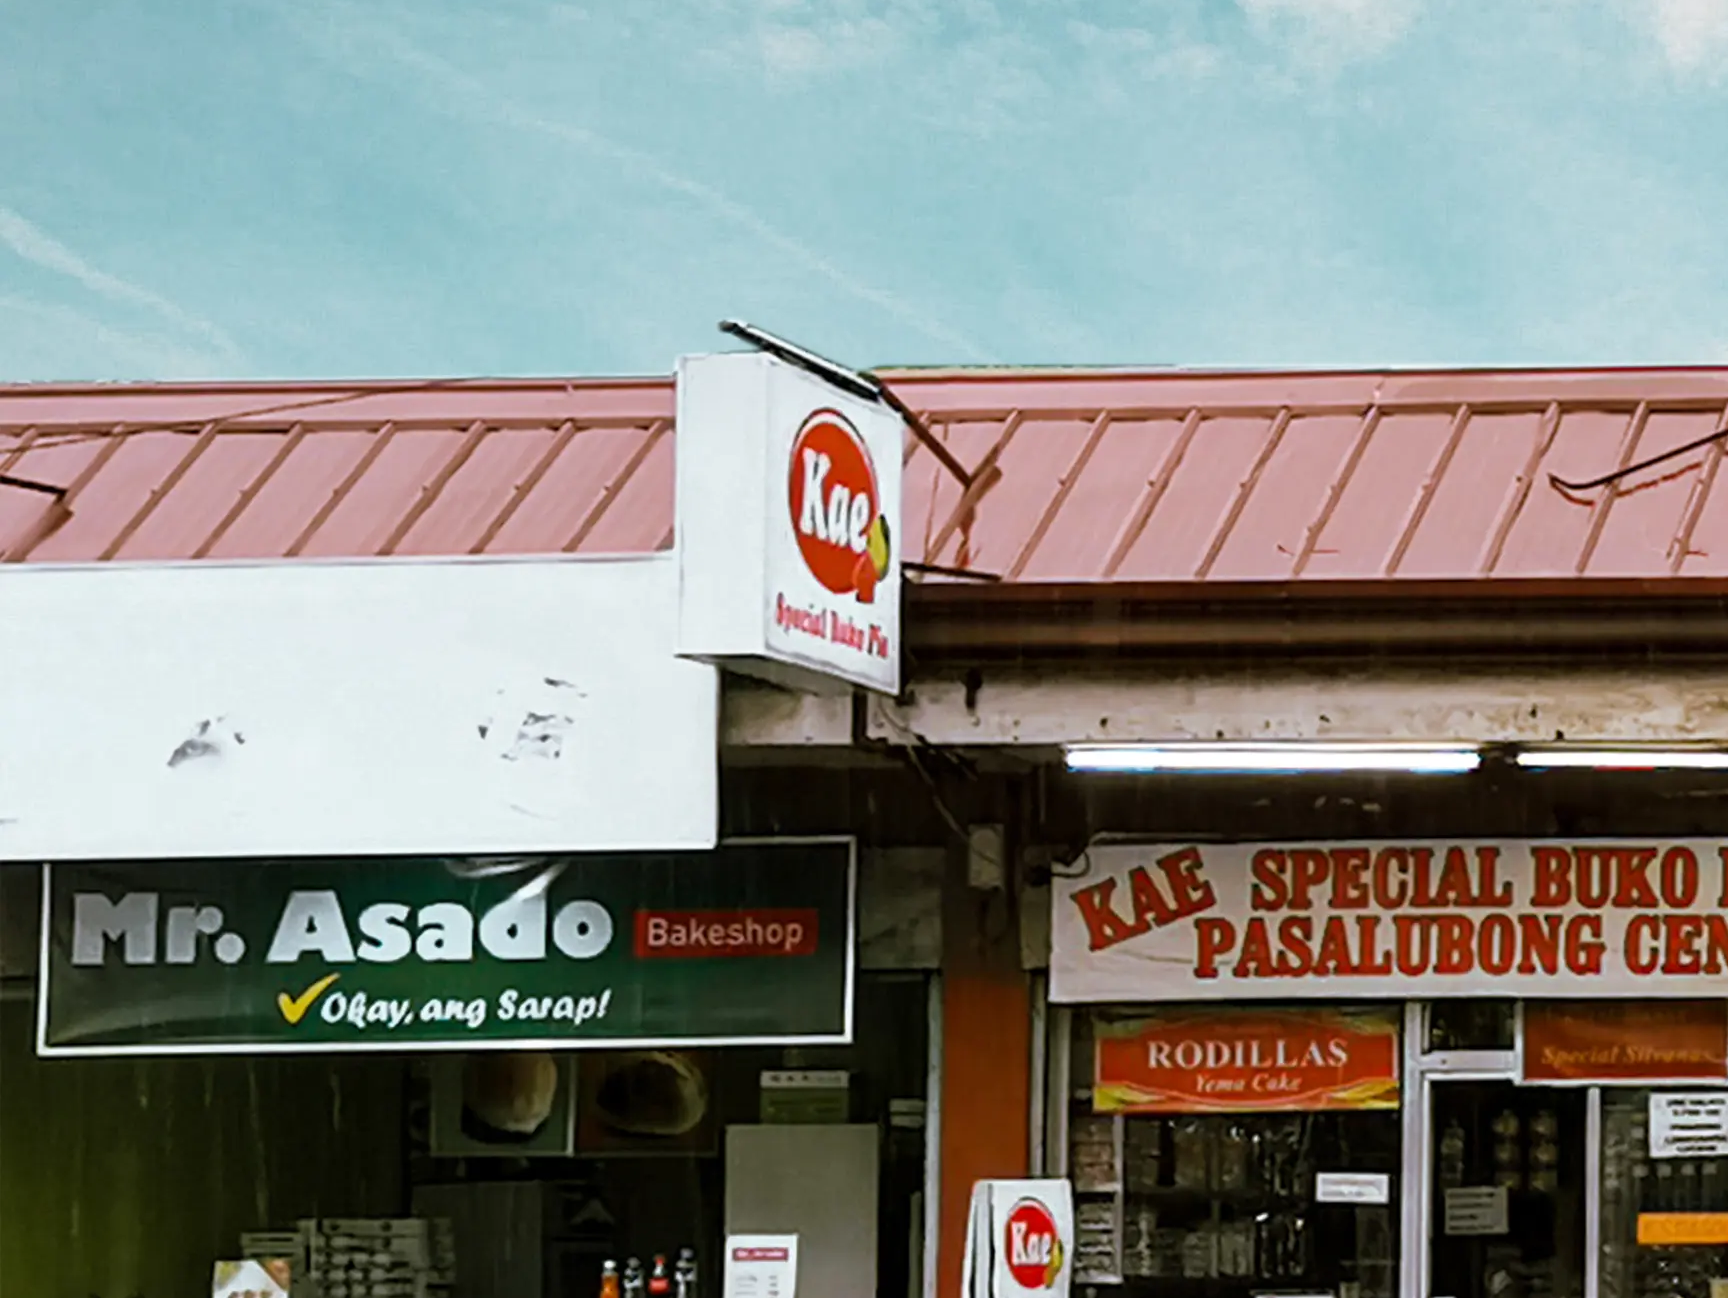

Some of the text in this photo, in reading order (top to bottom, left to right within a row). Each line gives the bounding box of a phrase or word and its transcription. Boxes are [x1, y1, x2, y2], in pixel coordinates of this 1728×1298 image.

[799, 446, 870, 554] Kae
[1068, 845, 1217, 953] KAE
[1248, 845, 1515, 912] SPECIAL
[1529, 844, 1699, 911] BUKO
[71, 881, 614, 966] Mr. Asado
[646, 915, 804, 953] Bakeshop
[1194, 912, 1607, 979] PASALUBONG
[320, 988, 612, 1029] Okay, ang Sarap!
[1146, 1038, 1349, 1072] RODILLAS
[1011, 1220, 1053, 1266] Kae
